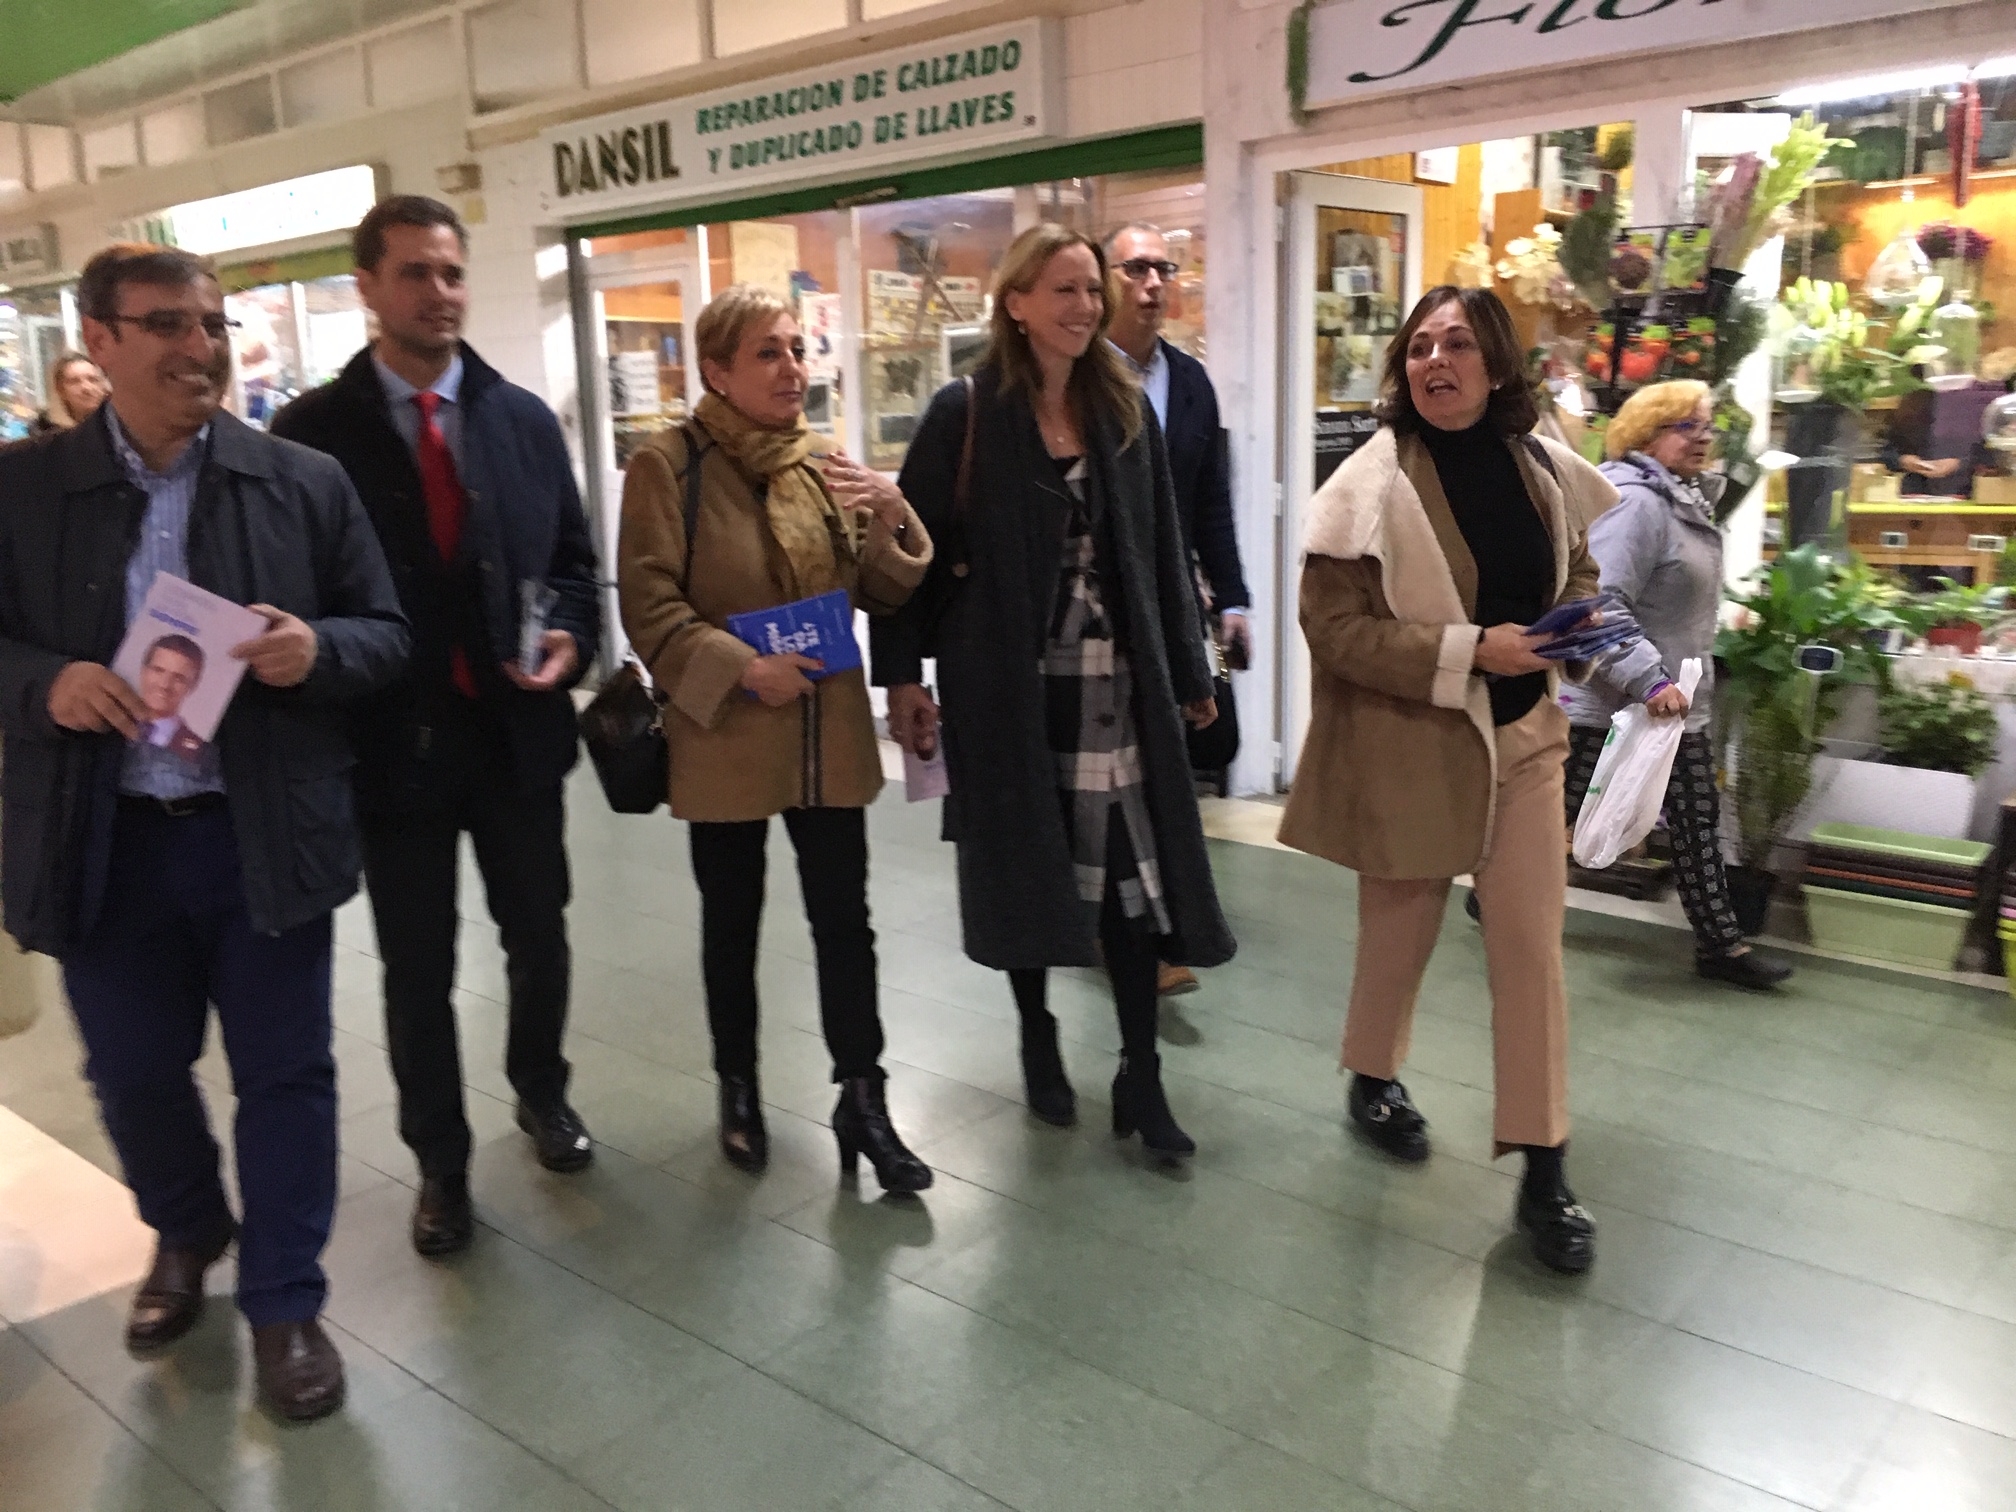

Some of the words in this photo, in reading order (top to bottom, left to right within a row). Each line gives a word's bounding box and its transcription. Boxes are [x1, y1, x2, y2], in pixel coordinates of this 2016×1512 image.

[696, 79, 844, 134] REPARACION
[854, 70, 887, 102] DE
[897, 40, 1021, 92] CALZADO
[553, 119, 680, 197] DANSIL
[707, 148, 722, 174] Y
[730, 121, 863, 170] DUPLICADO
[874, 113, 907, 144] DE
[917, 91, 1015, 136] LLAVES
